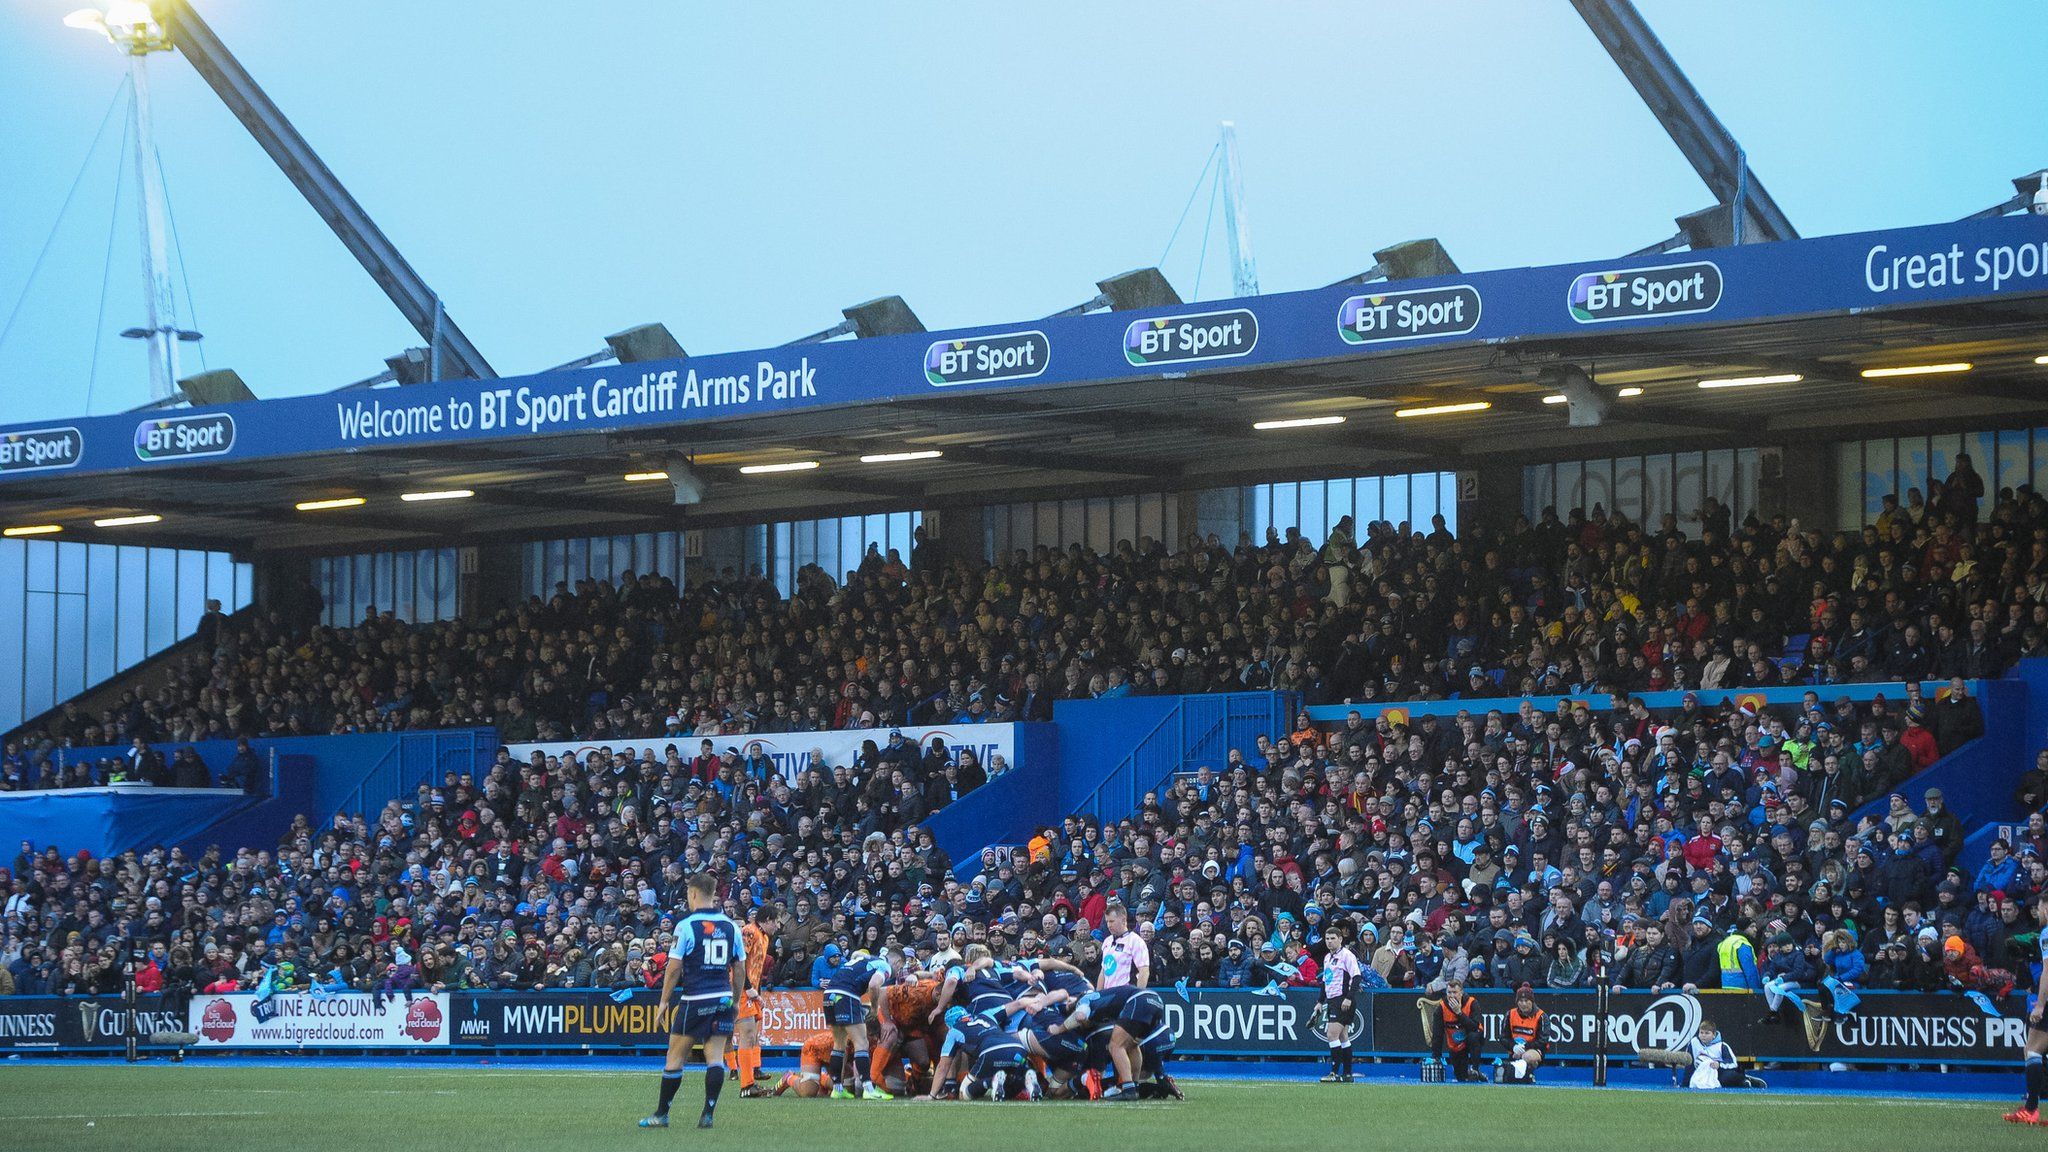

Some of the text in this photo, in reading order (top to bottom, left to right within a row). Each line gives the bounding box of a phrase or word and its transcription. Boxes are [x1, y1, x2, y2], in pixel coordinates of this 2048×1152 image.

[1865, 243, 1965, 293] Great
[1587, 272, 1704, 311] BT Sport
[1356, 295, 1464, 332] BT Sport
[1140, 319, 1242, 354] BT Sport
[940, 340, 1034, 375] BT Sport
[337, 357, 817, 440] Welcome to BT Sport Cardiff Arms Park
[0, 435, 72, 465] BT Sport
[147, 422, 224, 452] BT Sport
[702, 938, 729, 965] 10
[99, 1008, 184, 1036] GUNNESS
[251, 1022, 384, 1043] www.bigredcloud.com
[460, 1018, 490, 1035] MWH
[503, 1004, 680, 1034] MWHPLUMBIN
[762, 1007, 827, 1030] DS Smith
[1194, 1004, 1298, 1040] ROVER
[1644, 1010, 1680, 1048] 14
[1835, 1011, 2029, 1047] GUINNESS PR
